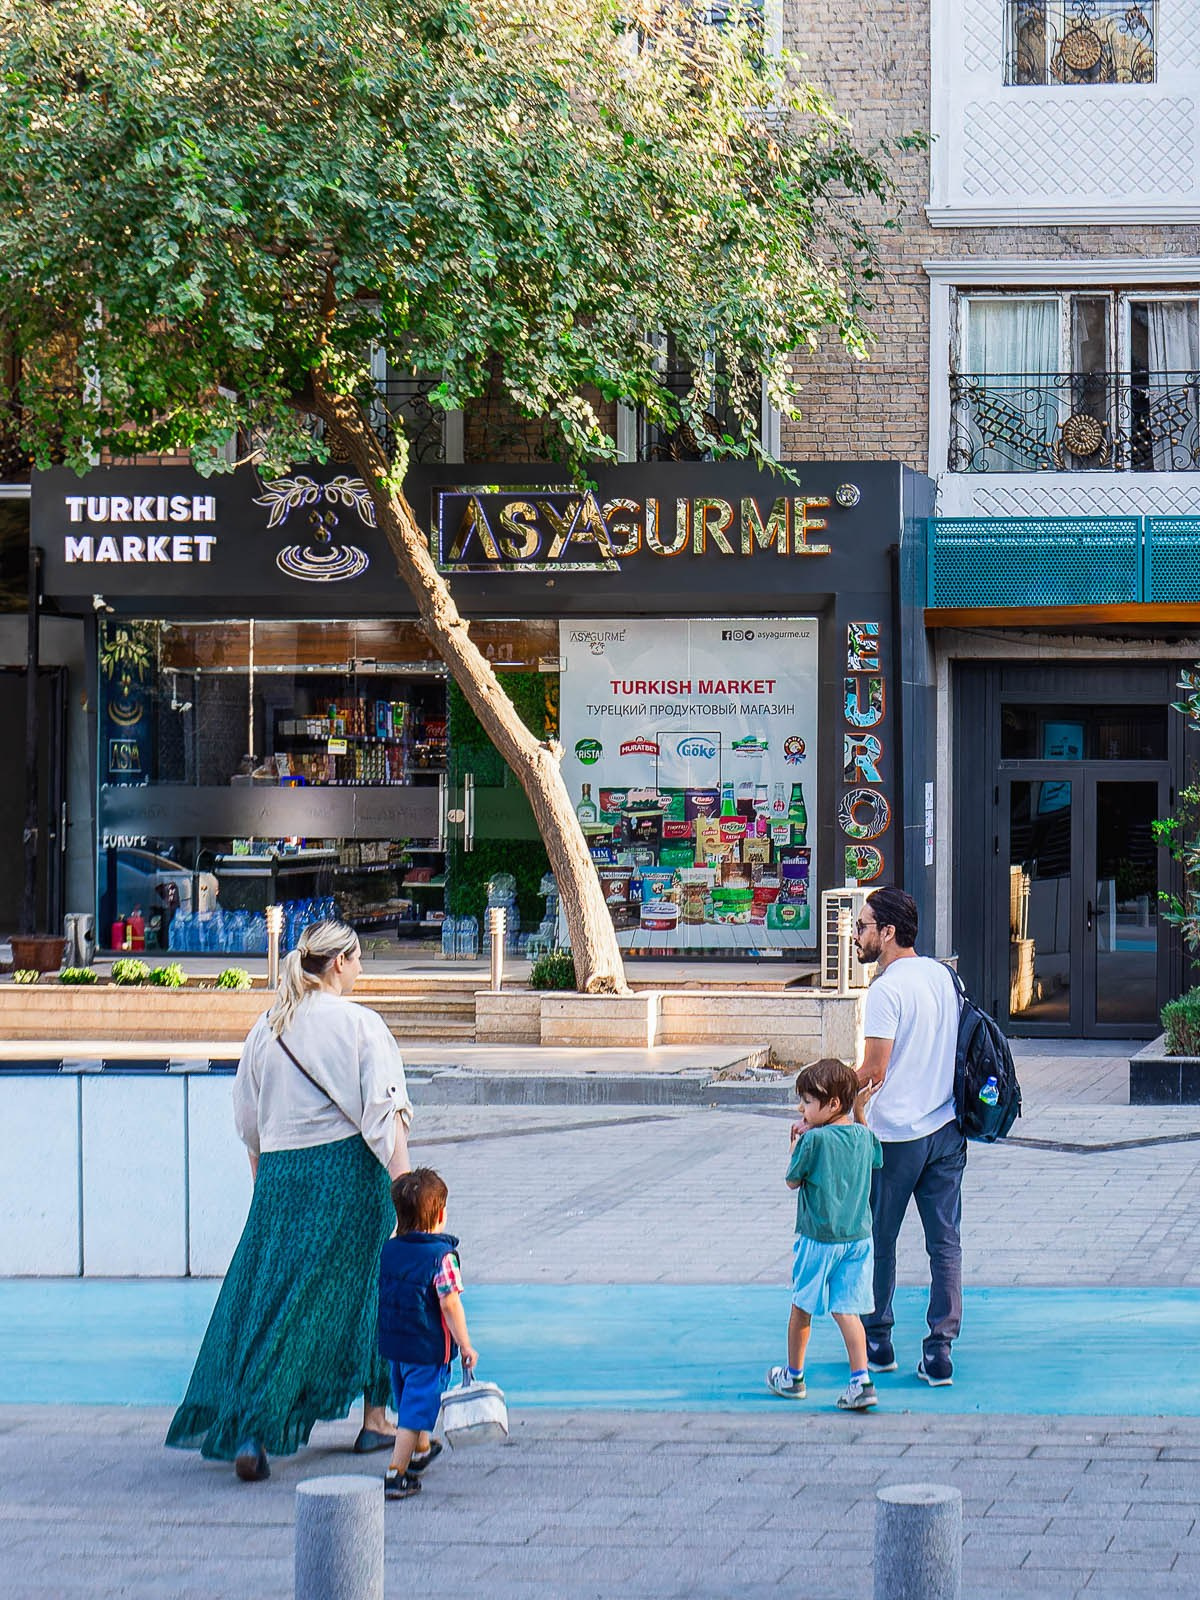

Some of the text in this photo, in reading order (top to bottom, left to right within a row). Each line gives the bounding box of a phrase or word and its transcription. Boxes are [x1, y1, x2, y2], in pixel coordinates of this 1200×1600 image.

[65, 495, 216, 523] TURKISH
[448, 491, 832, 559] ASYAGURME
[65, 535, 217, 563] MARKET
[757, 630, 810, 641] asyagurme.uz
[610, 680, 776, 695] TURKISH MARKET
[587, 703, 795, 717] ТУРЕЦКИЙ ПРОДУКТОВЫЙ МАГАЗИН
